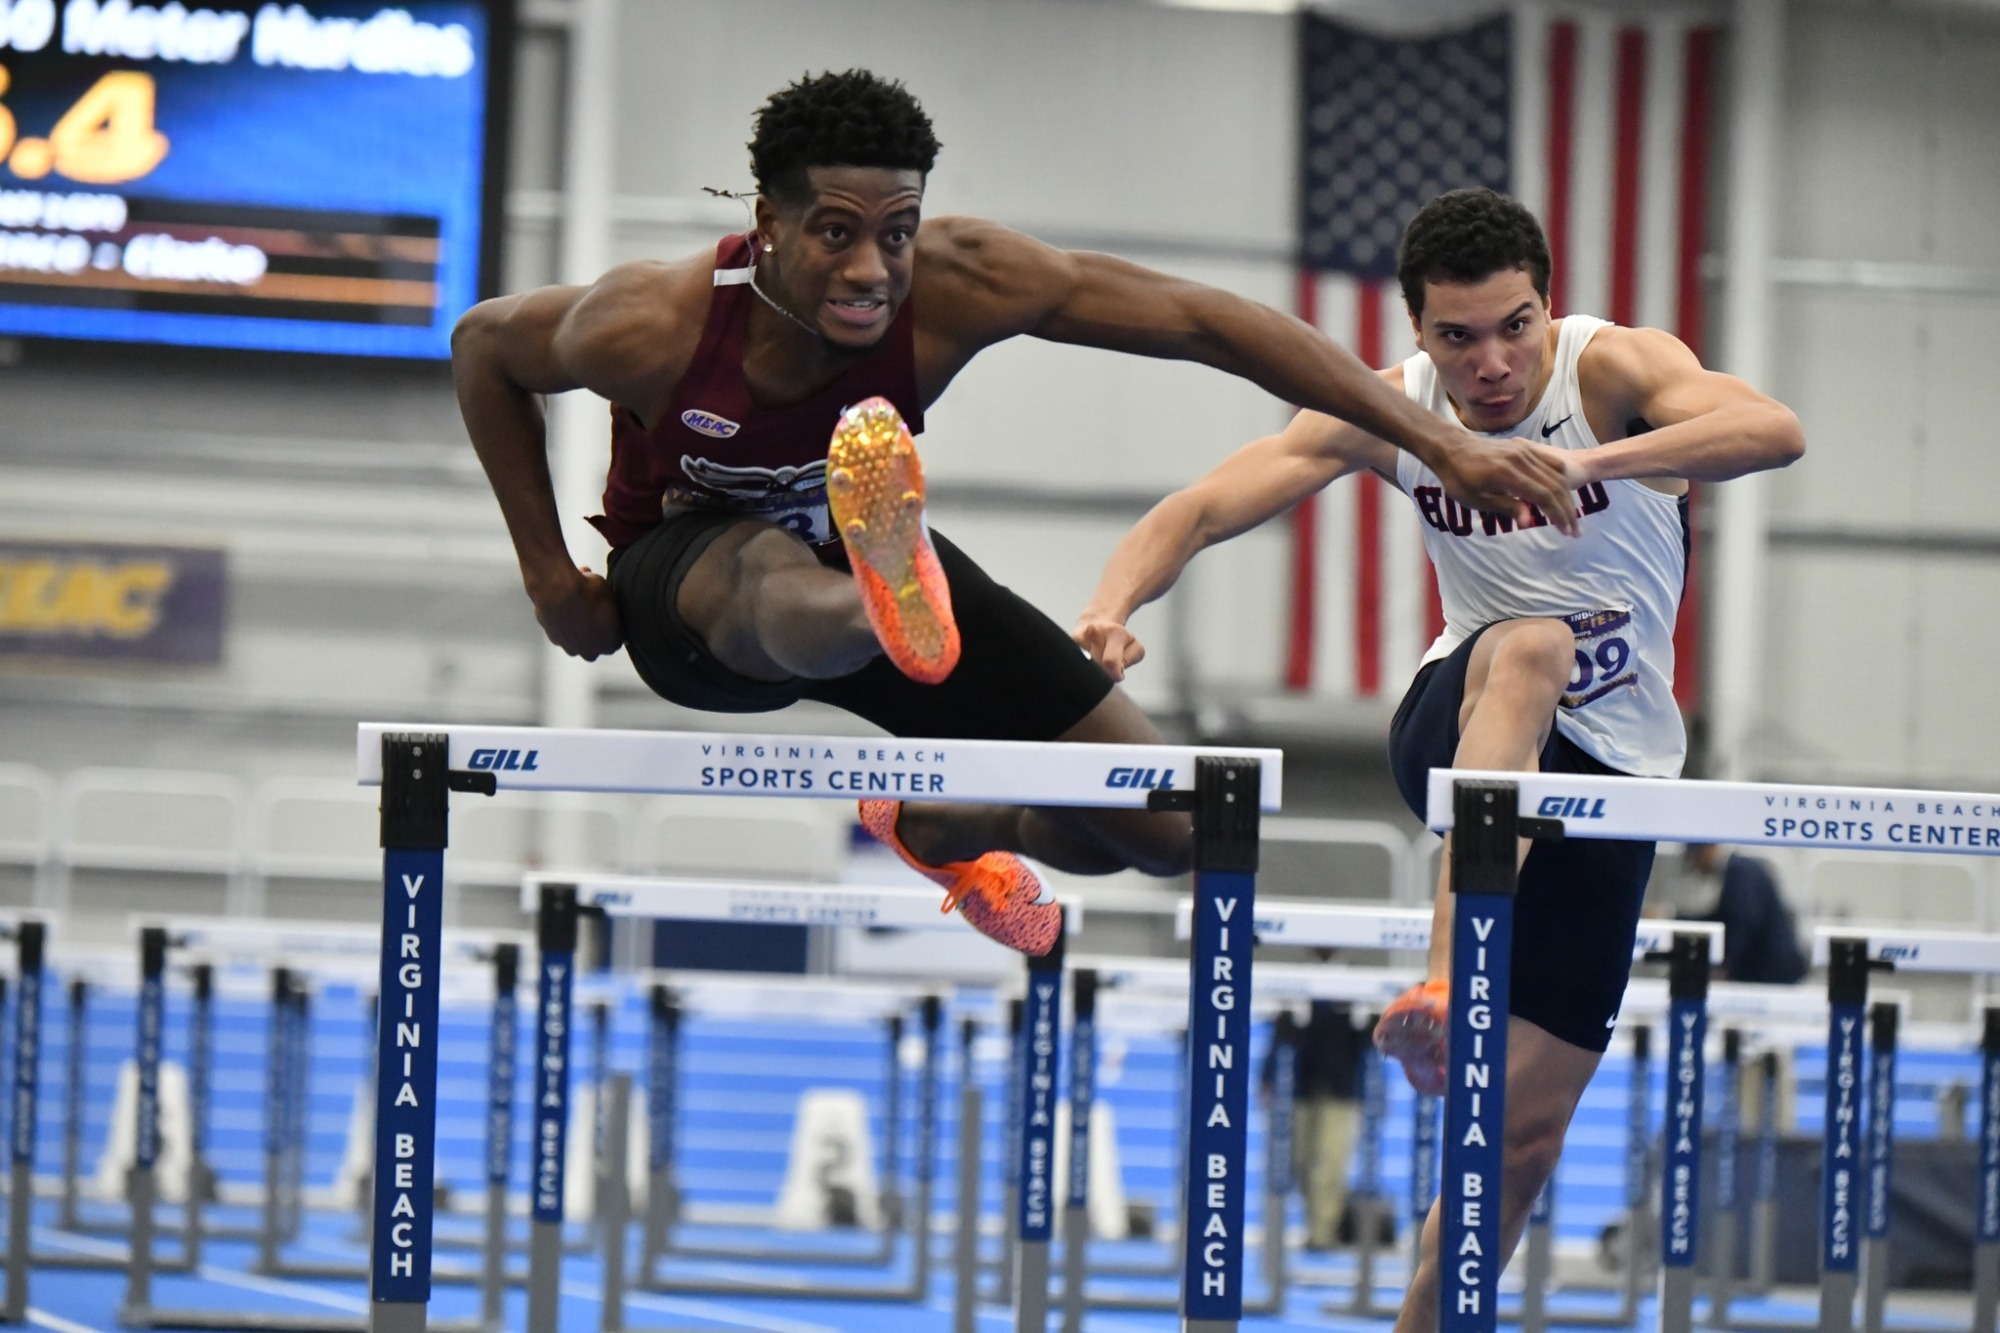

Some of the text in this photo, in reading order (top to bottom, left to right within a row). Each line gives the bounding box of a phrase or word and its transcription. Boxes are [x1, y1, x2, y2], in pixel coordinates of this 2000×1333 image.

[686, 411, 737, 435] MEAC
[468, 748, 539, 770] GILL
[702, 745, 945, 763] VIRGINIA BEACH
[701, 767, 944, 793] SPORTS CENTER
[1105, 767, 1175, 790] GILL
[1537, 796, 1606, 819] GILL
[1765, 796, 2000, 818] VIRGINIA BEACH
[1764, 818, 2000, 848] SPORTS CENTER
[391, 874, 425, 1277] VIRGINIA BEACH
[538, 963, 566, 1211] VIRGINIA BEACH
[1027, 983, 1054, 1228] VIRGINIA BEACH
[1203, 897, 1237, 1297] VIRGINIA BEACH
[1458, 917, 1495, 1315] VIRGINIA BEACH
[1671, 1011, 1697, 1255] VIRGINIA BEACH
[1832, 1016, 1856, 1260] VIRGINIA BEACH
